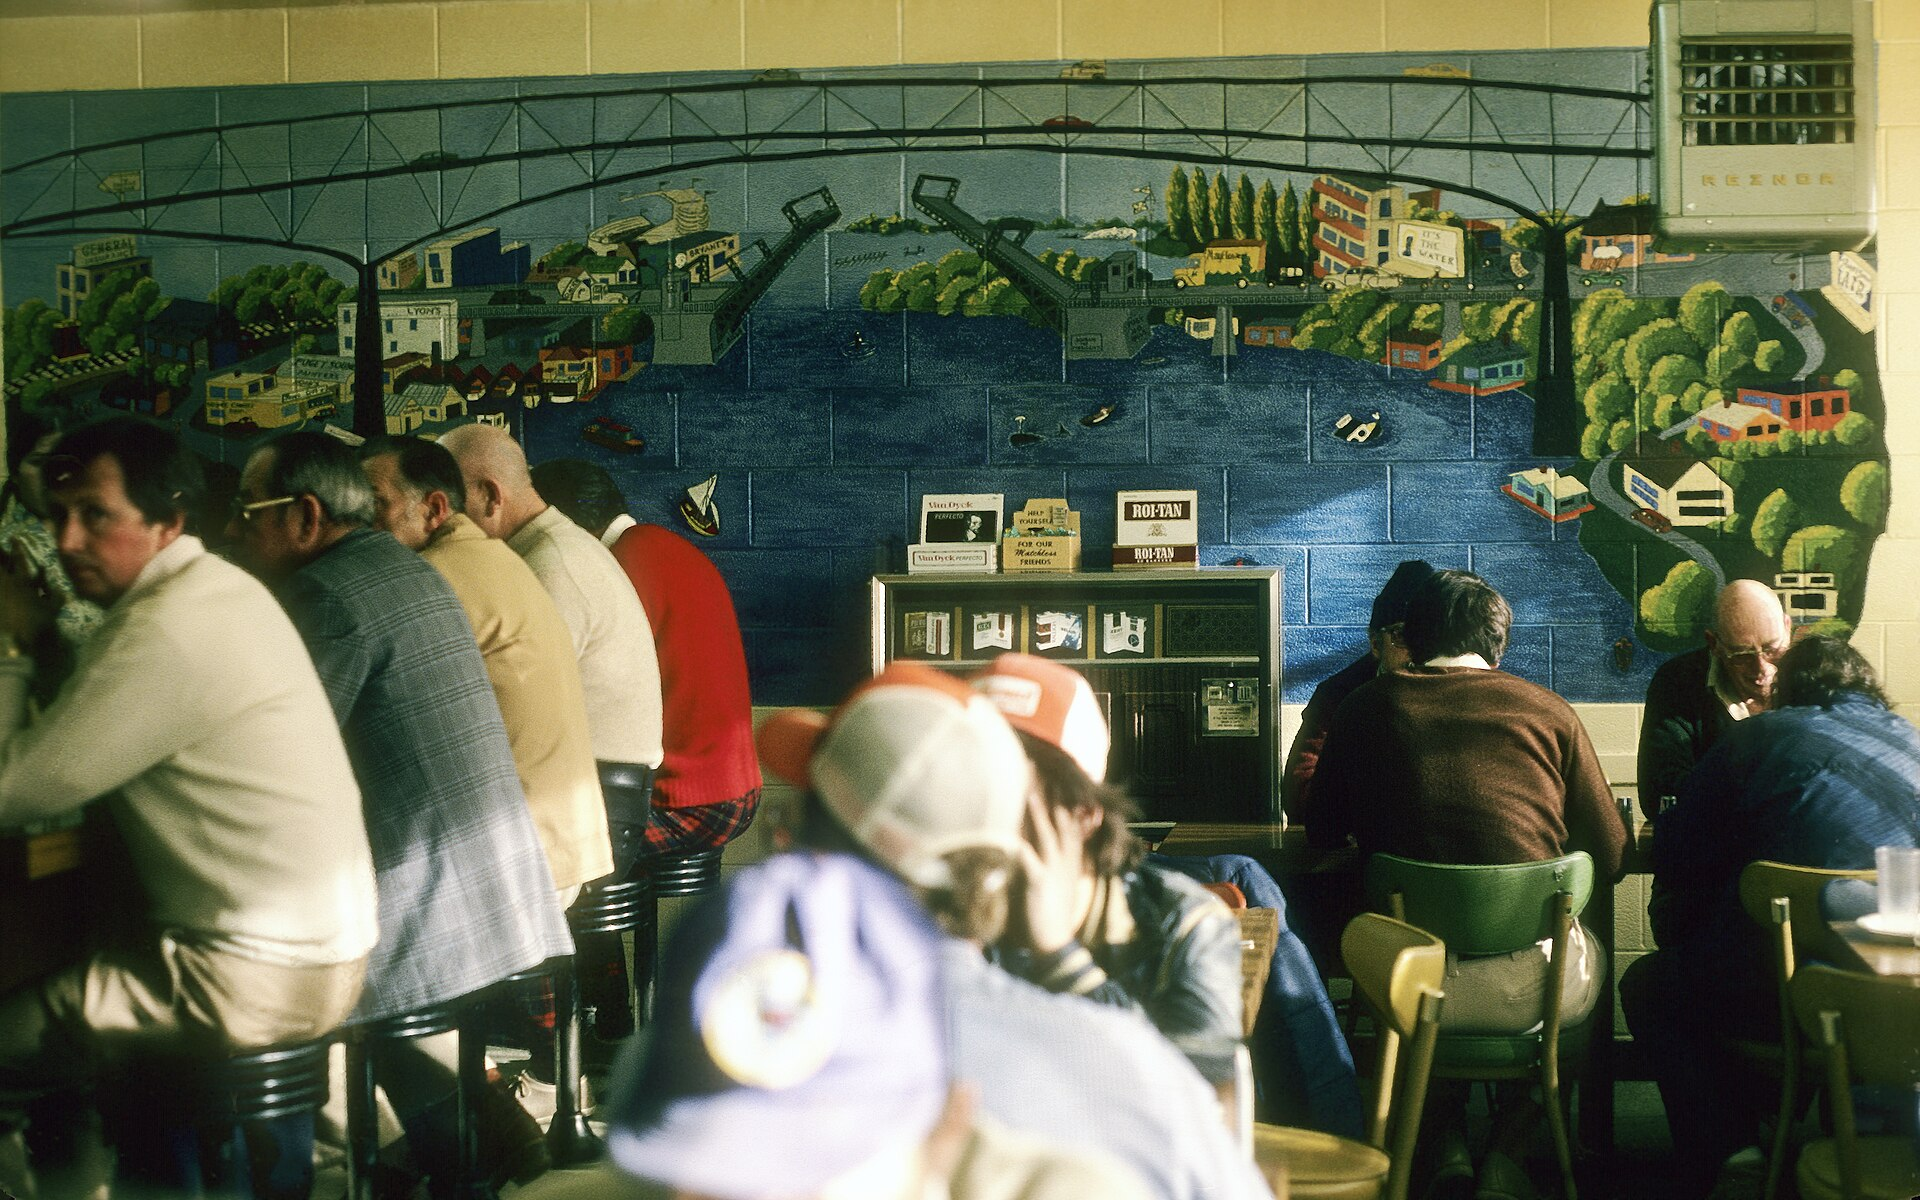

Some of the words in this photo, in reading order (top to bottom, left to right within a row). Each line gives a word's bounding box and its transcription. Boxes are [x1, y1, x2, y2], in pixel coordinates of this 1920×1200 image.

[1702, 173, 1834, 187] REZNOR
[1422, 230, 1441, 239] IT'S
[81, 237, 133, 257] GENERAL
[689, 238, 728, 258] BRYANT'S
[1420, 239, 1440, 250] THE
[1418, 250, 1456, 266] WATER
[407, 307, 442, 315] LYON'S
[928, 501, 947, 509] Van
[948, 501, 974, 510] Dyck
[1015, 549, 1057, 557] Matchless
[917, 554, 936, 562] Van
[936, 554, 956, 564] Dyck
[1019, 558, 1052, 566] FRIENDS
